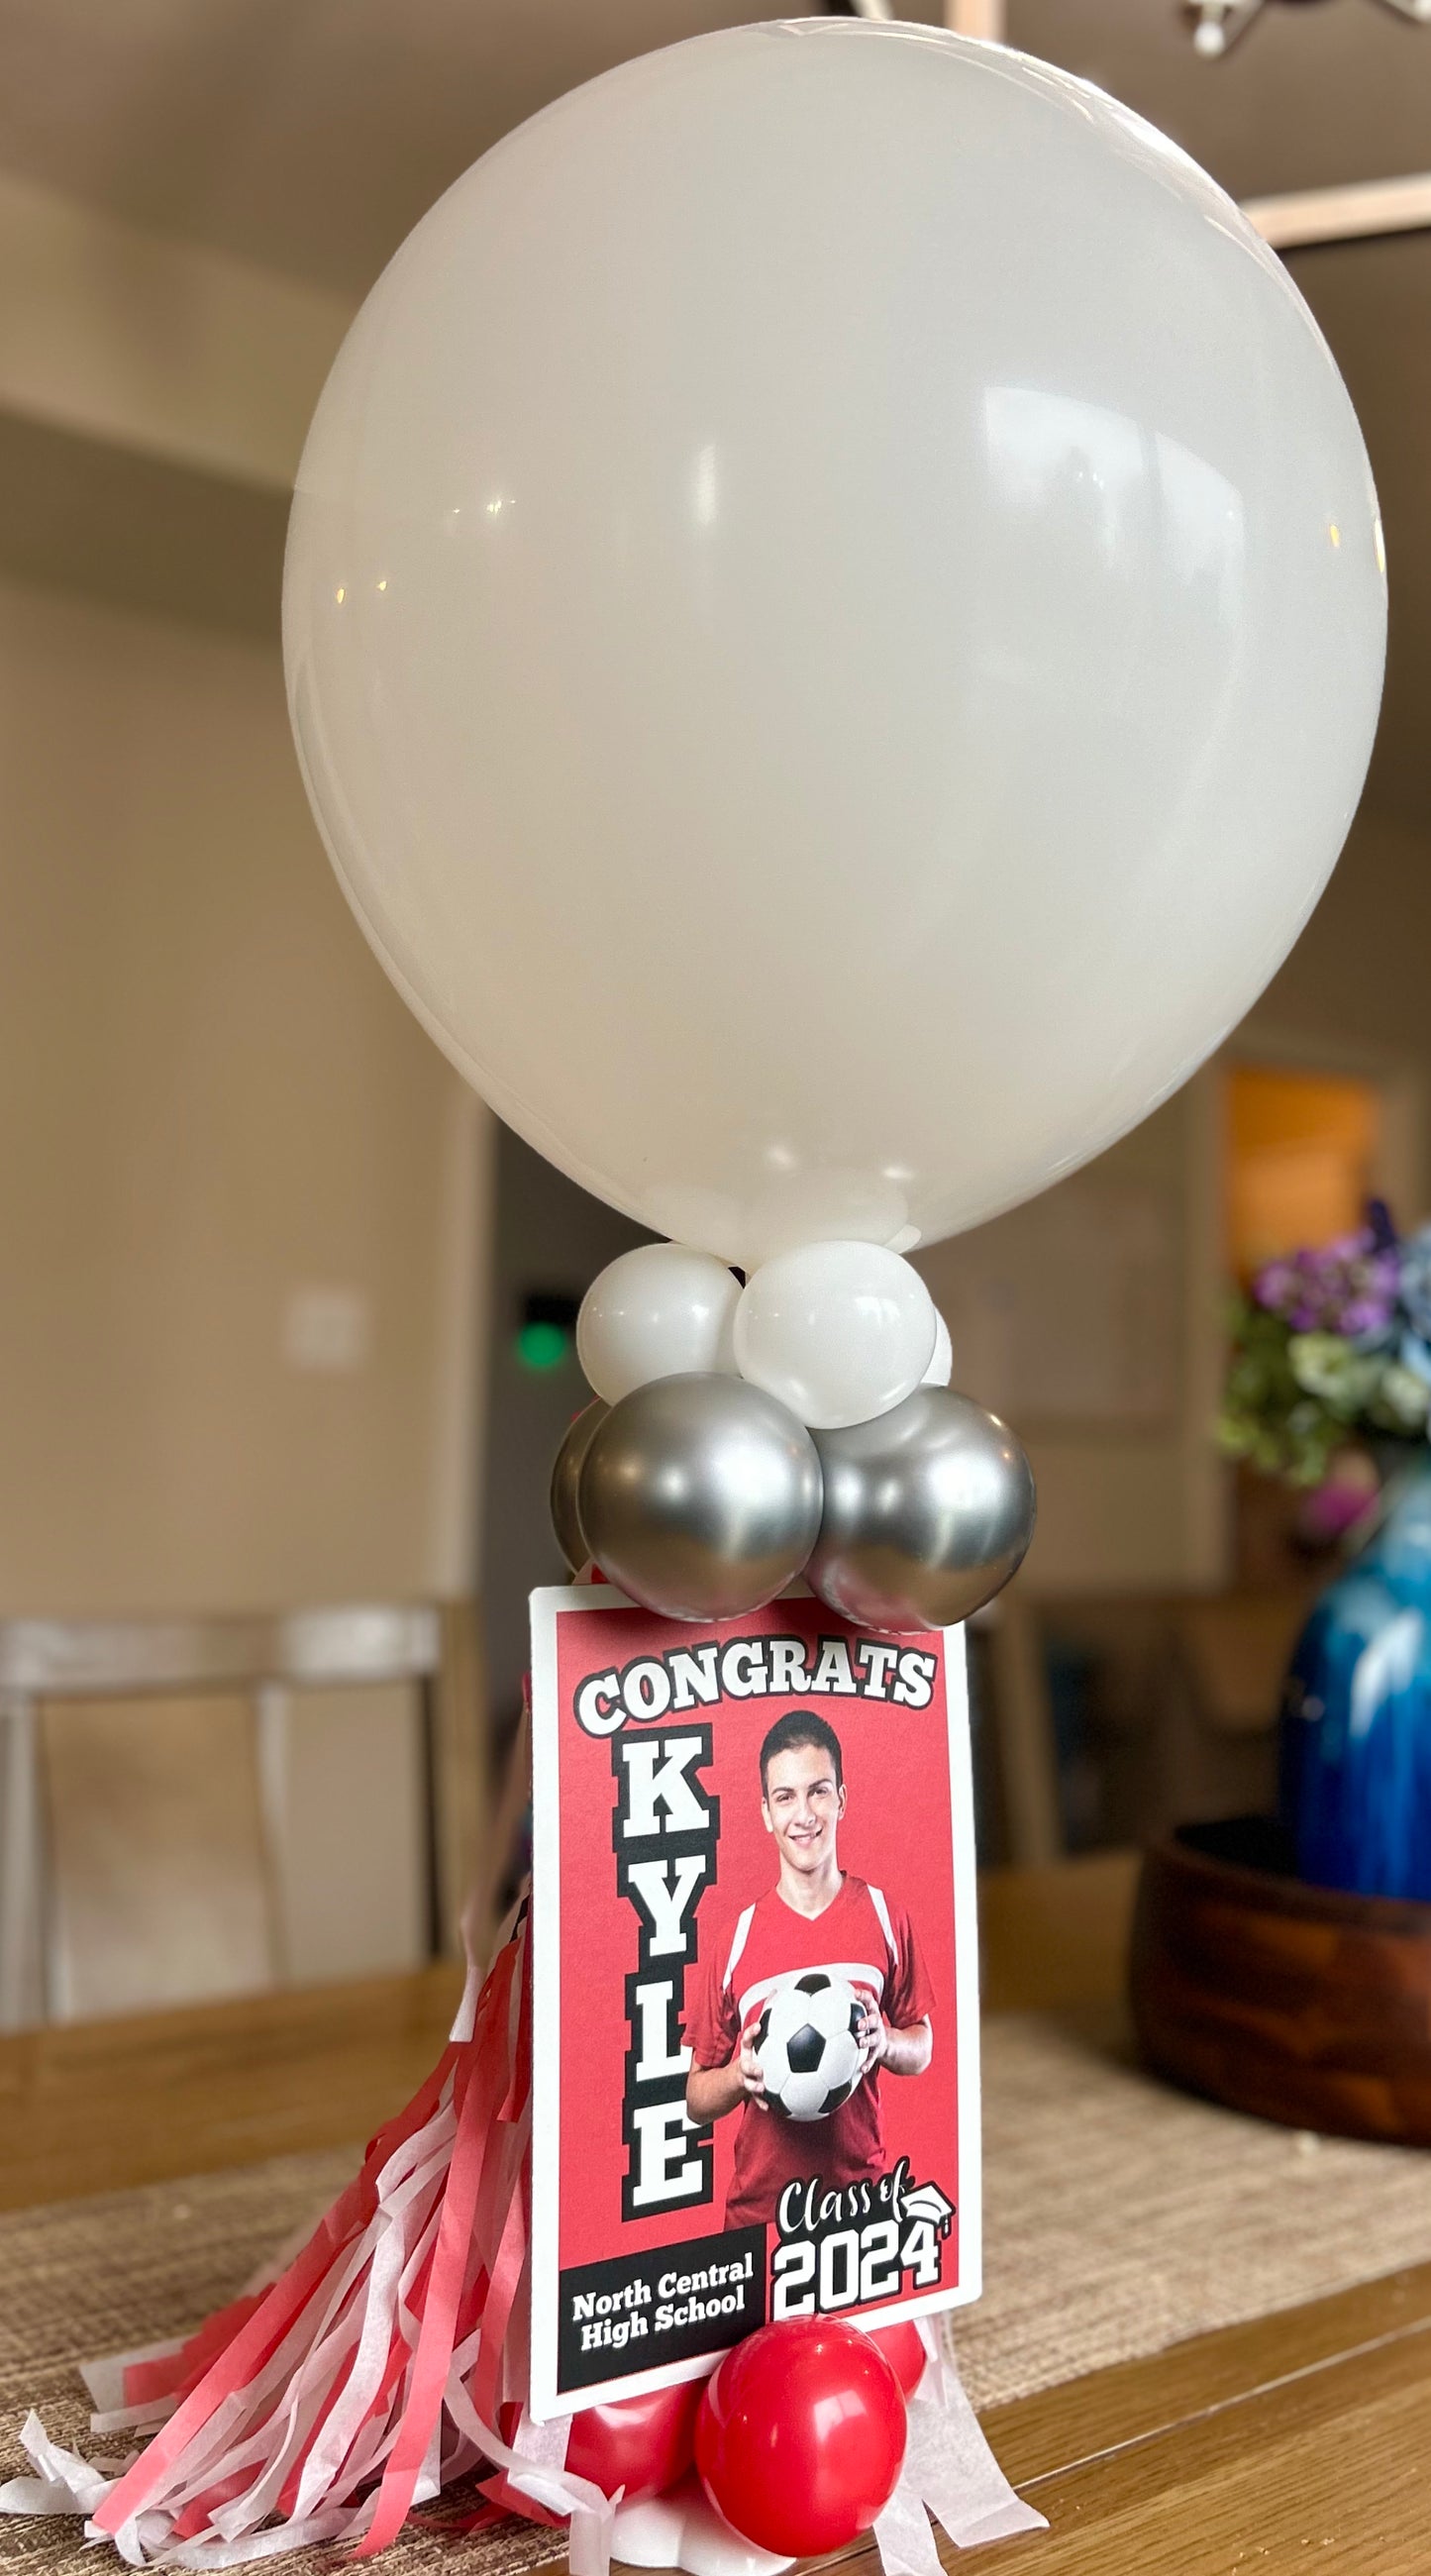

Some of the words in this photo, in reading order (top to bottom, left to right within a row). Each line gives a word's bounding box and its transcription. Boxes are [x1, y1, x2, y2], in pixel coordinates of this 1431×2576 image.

[578, 1640, 936, 1735] CONGRATS
[622, 1736, 710, 2207] KYLE
[778, 2178, 871, 2233] Class
[880, 2160, 912, 2220] of
[572, 2280, 652, 2321] North
[658, 2251, 754, 2298] Central
[773, 2219, 940, 2320] 2024
[580, 2314, 650, 2351] High
[654, 2284, 746, 2331] School
